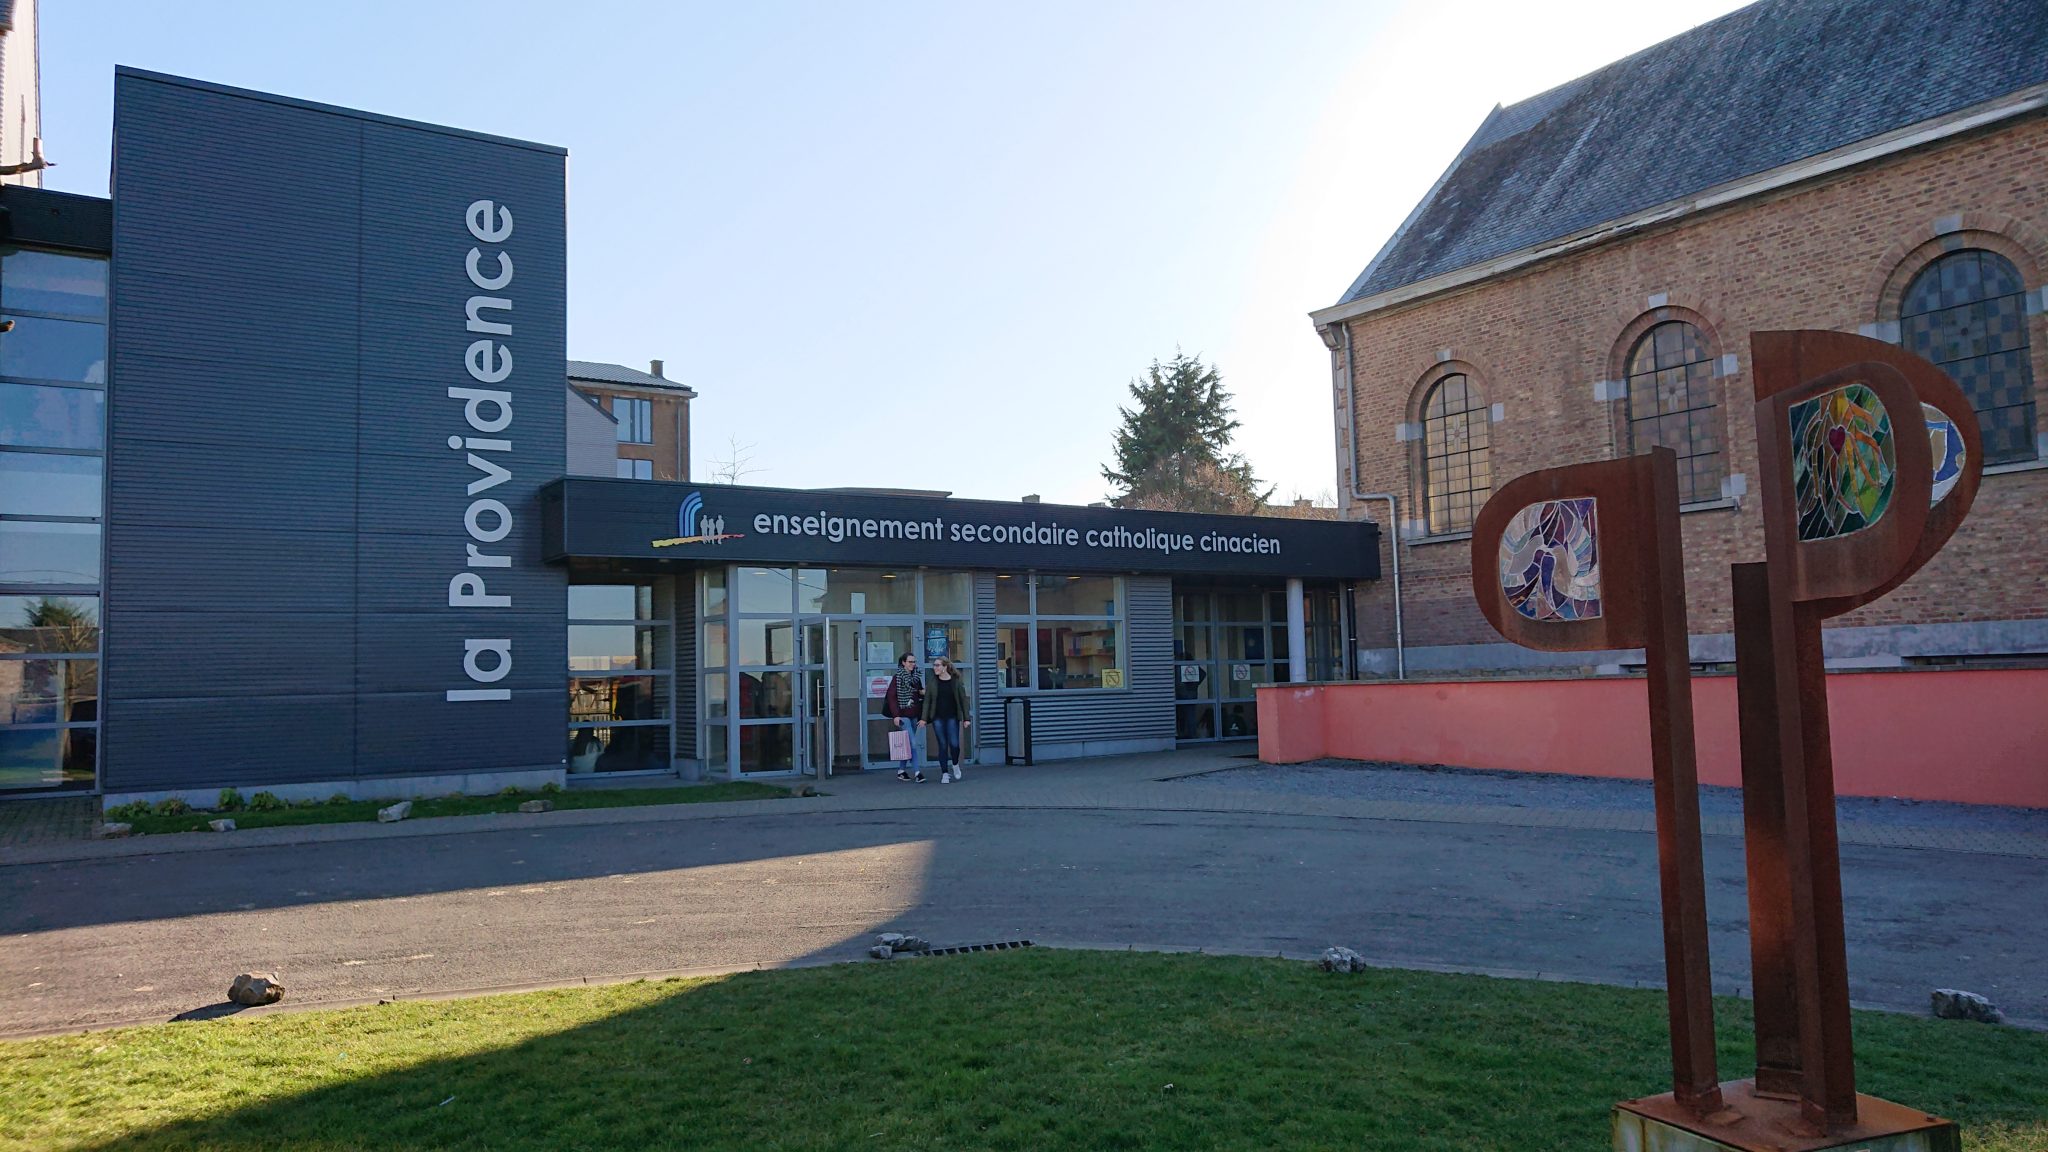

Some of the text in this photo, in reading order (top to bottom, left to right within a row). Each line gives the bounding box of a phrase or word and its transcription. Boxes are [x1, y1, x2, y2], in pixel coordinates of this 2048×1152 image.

[446, 199, 513, 702] la Providence
[753, 510, 1281, 555] enseignement secondaire catholique cinacien
